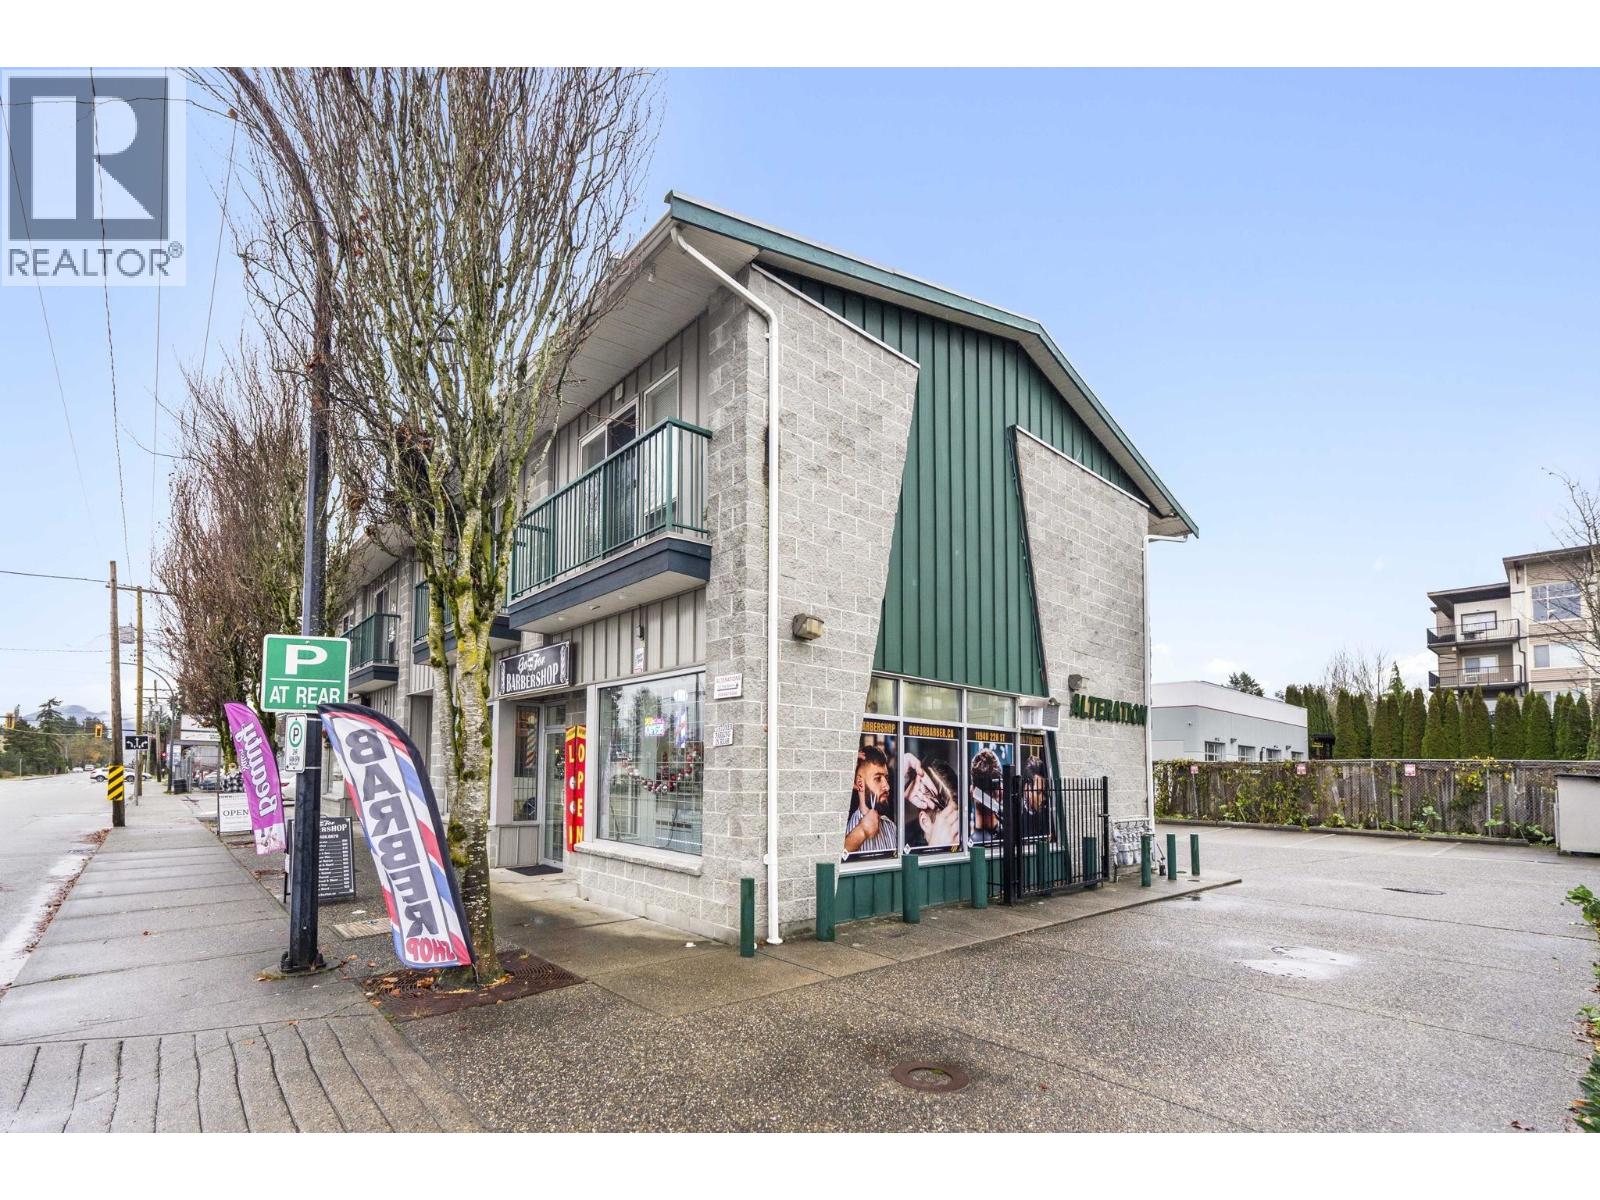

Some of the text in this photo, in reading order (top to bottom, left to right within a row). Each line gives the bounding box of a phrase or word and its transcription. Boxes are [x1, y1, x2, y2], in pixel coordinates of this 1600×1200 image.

[285, 644, 328, 675] P
[506, 662, 559, 693] BARBERSHOP
[269, 685, 341, 705] AT REAR
[293, 727, 300, 742] P
[576, 743, 585, 843] OPEN
[222, 809, 249, 817] OPEN
